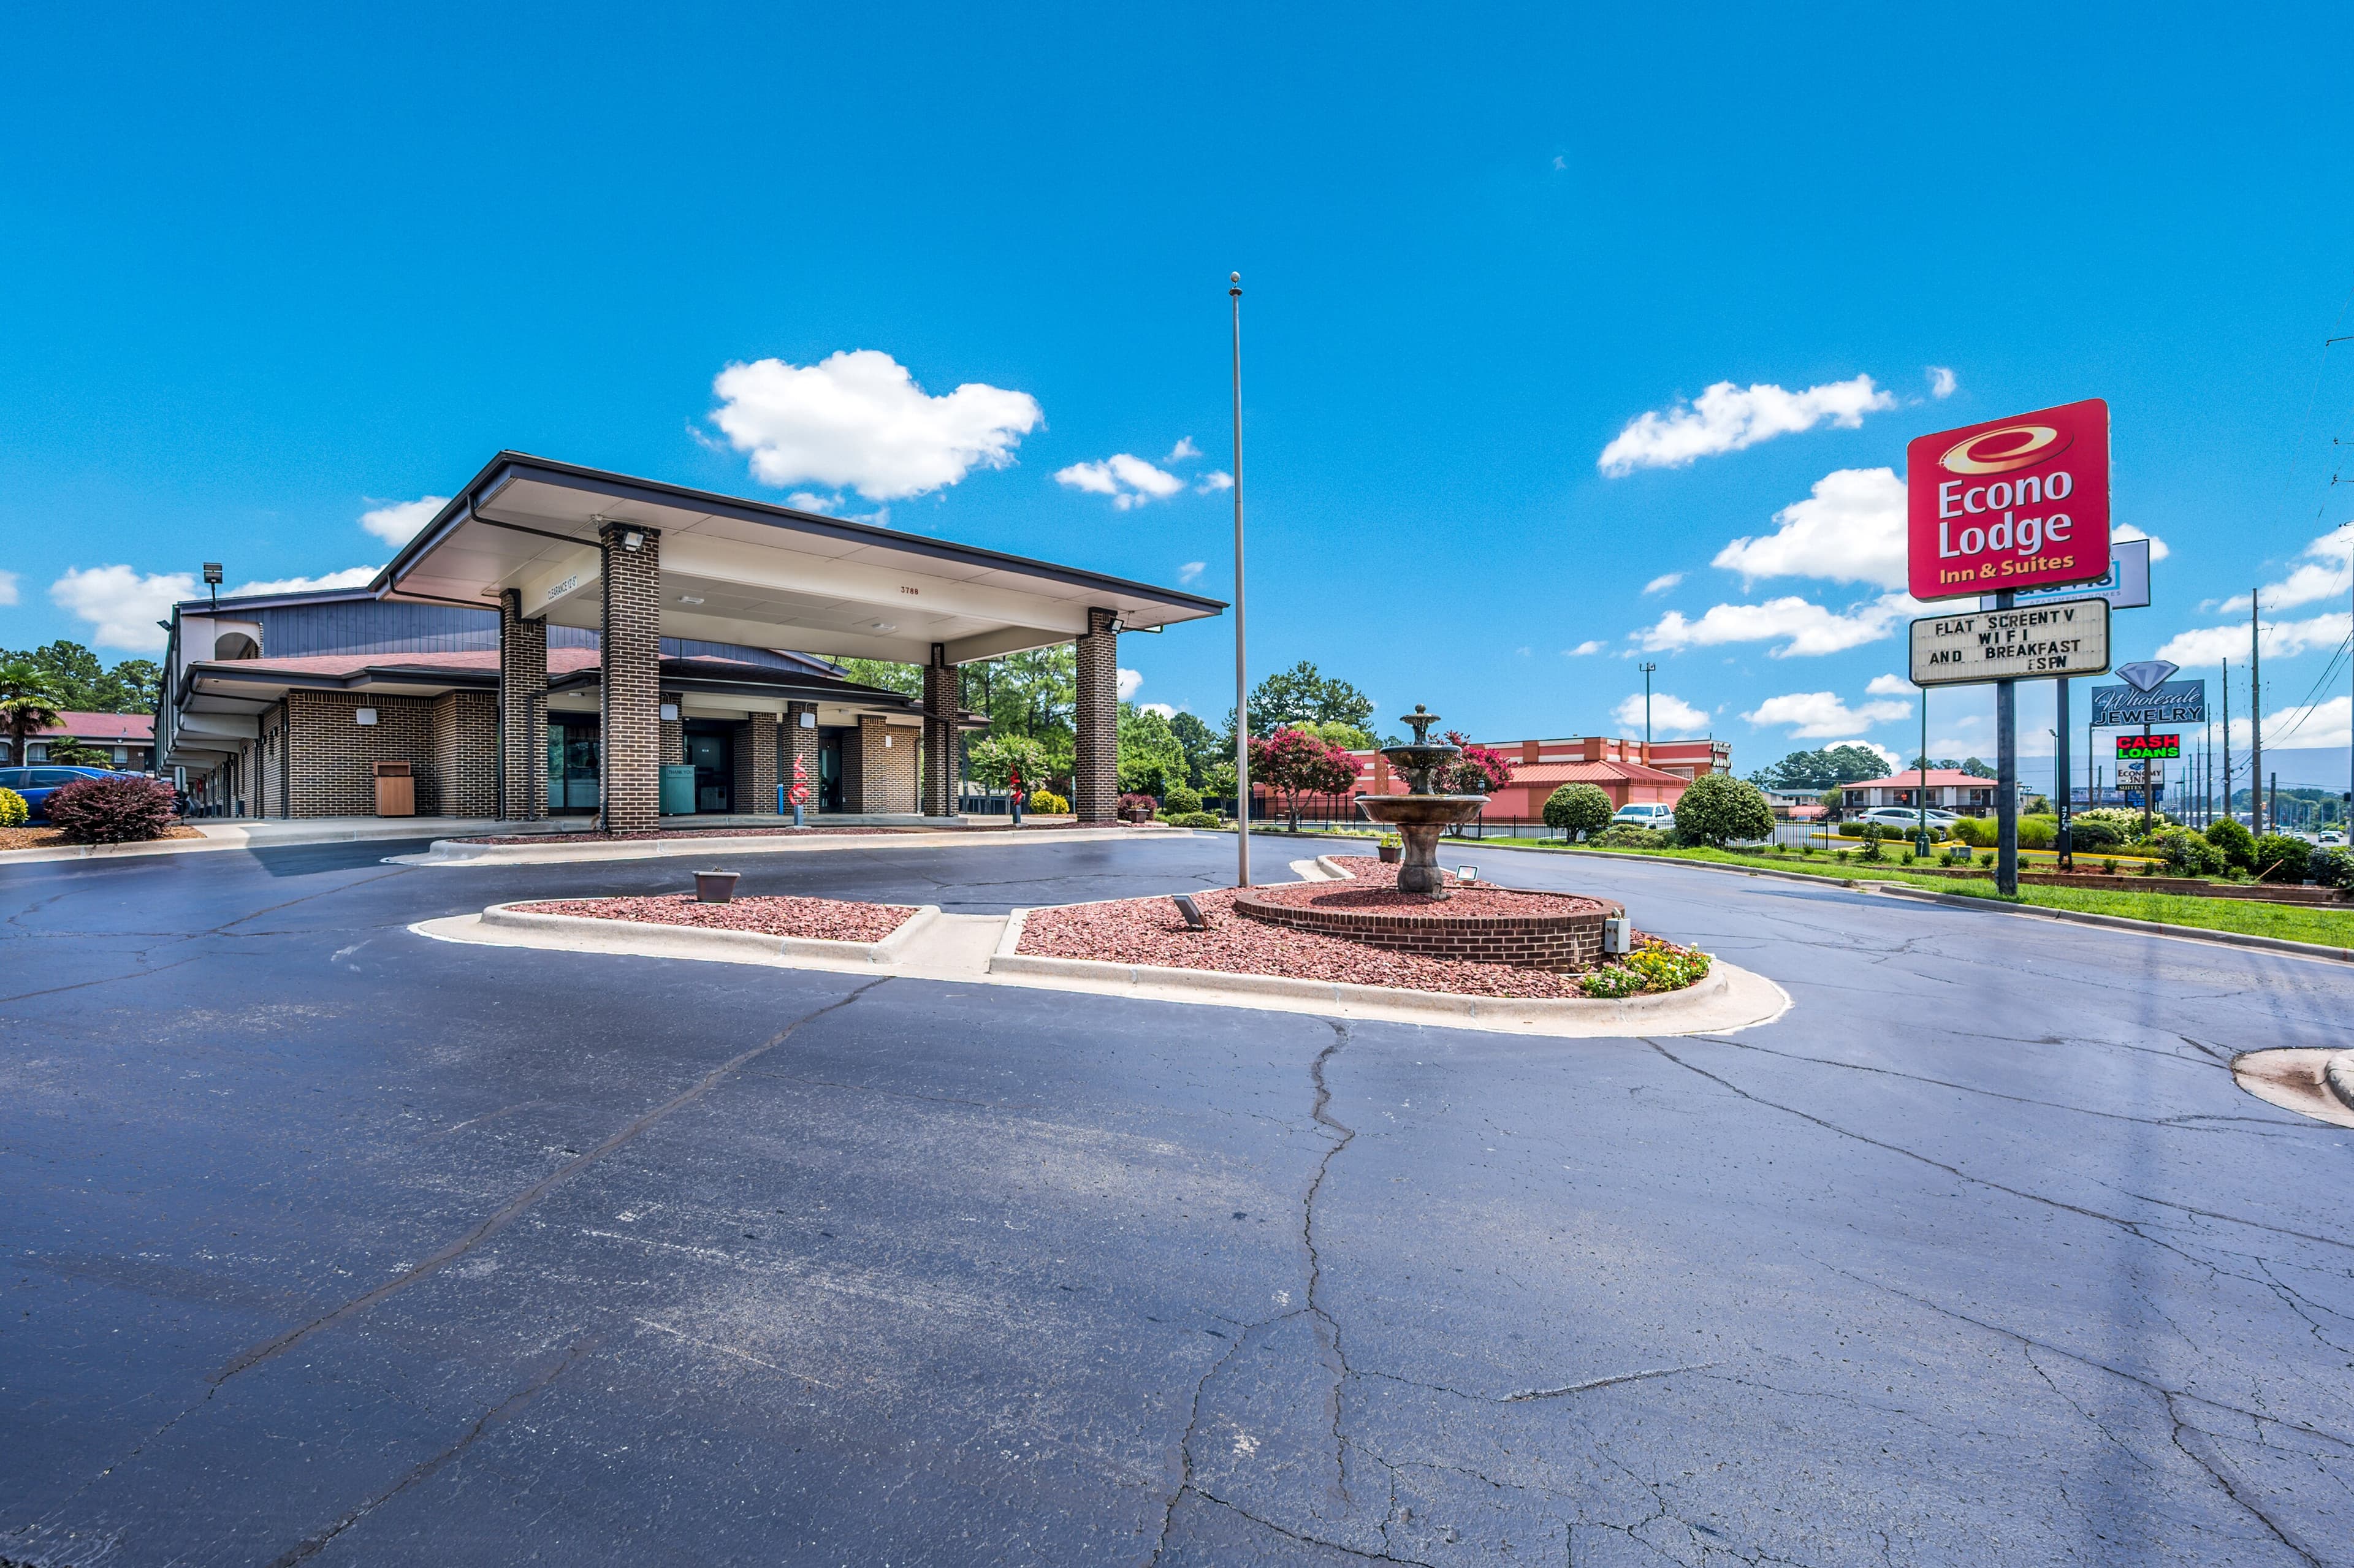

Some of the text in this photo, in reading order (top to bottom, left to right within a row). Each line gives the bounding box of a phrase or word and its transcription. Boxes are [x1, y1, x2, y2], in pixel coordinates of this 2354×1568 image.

[1939, 471, 2073, 520] Econo
[1939, 511, 2073, 559] Lodge
[1940, 555, 2075, 585] Inn & Suites
[901, 586, 918, 595] 3788
[2030, 590, 2121, 604] APARTMENT HOMES
[1935, 620, 1975, 635] FLAT
[1929, 639, 2081, 664] AND BREAKFAST
[2094, 686, 2201, 711] Wholesale
[2095, 706, 2203, 725] JEWELRY
[2117, 736, 2179, 748] CASH
[2118, 747, 2179, 759] LOANS
